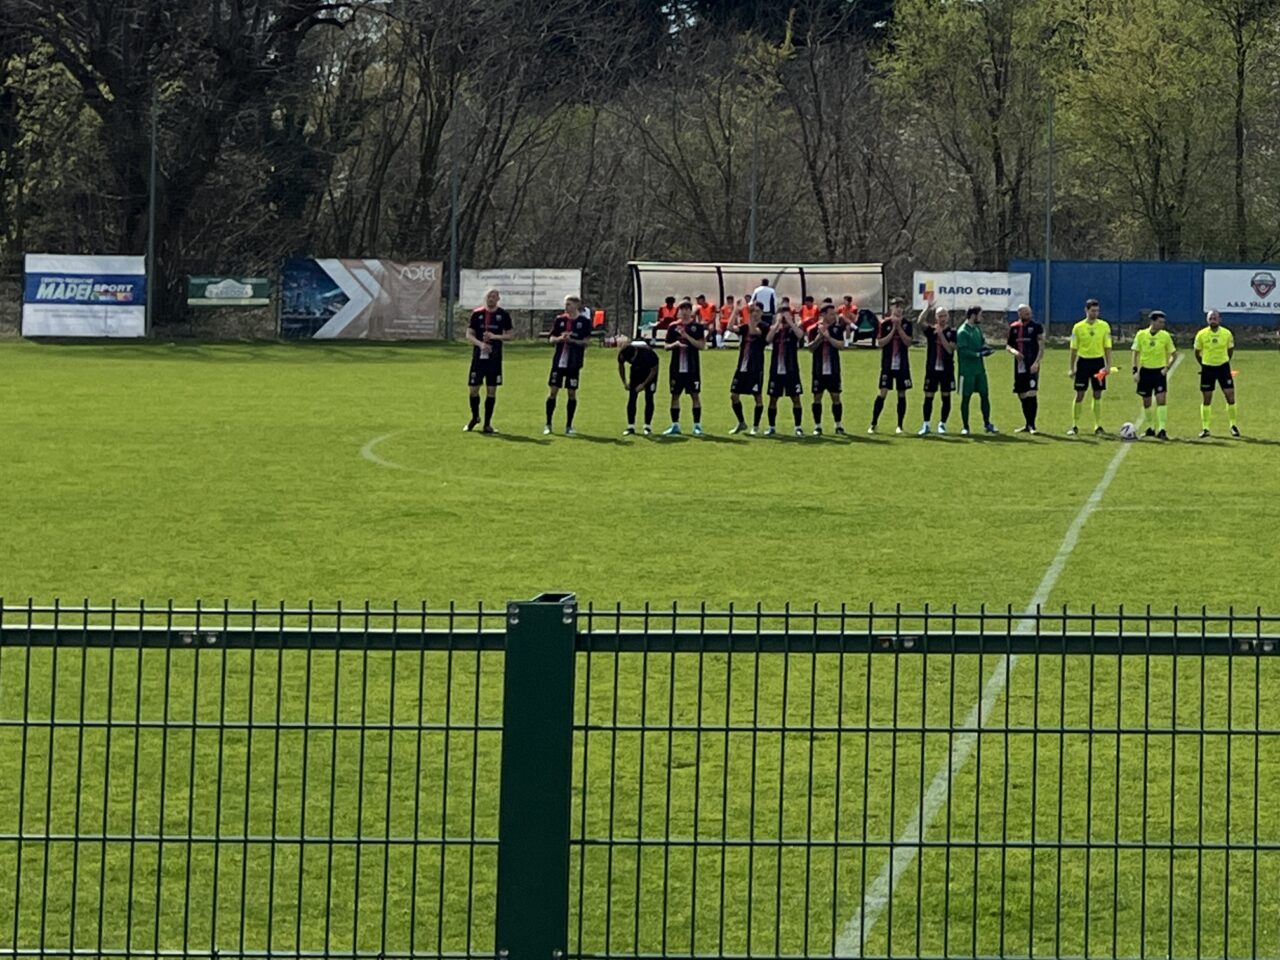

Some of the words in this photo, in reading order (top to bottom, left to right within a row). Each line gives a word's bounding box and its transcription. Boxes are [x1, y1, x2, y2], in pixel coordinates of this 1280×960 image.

[36, 283, 93, 300] MAPEI
[94, 283, 134, 292] SPORT
[938, 286, 973, 295] RARO
[976, 287, 1012, 296] CHEM
